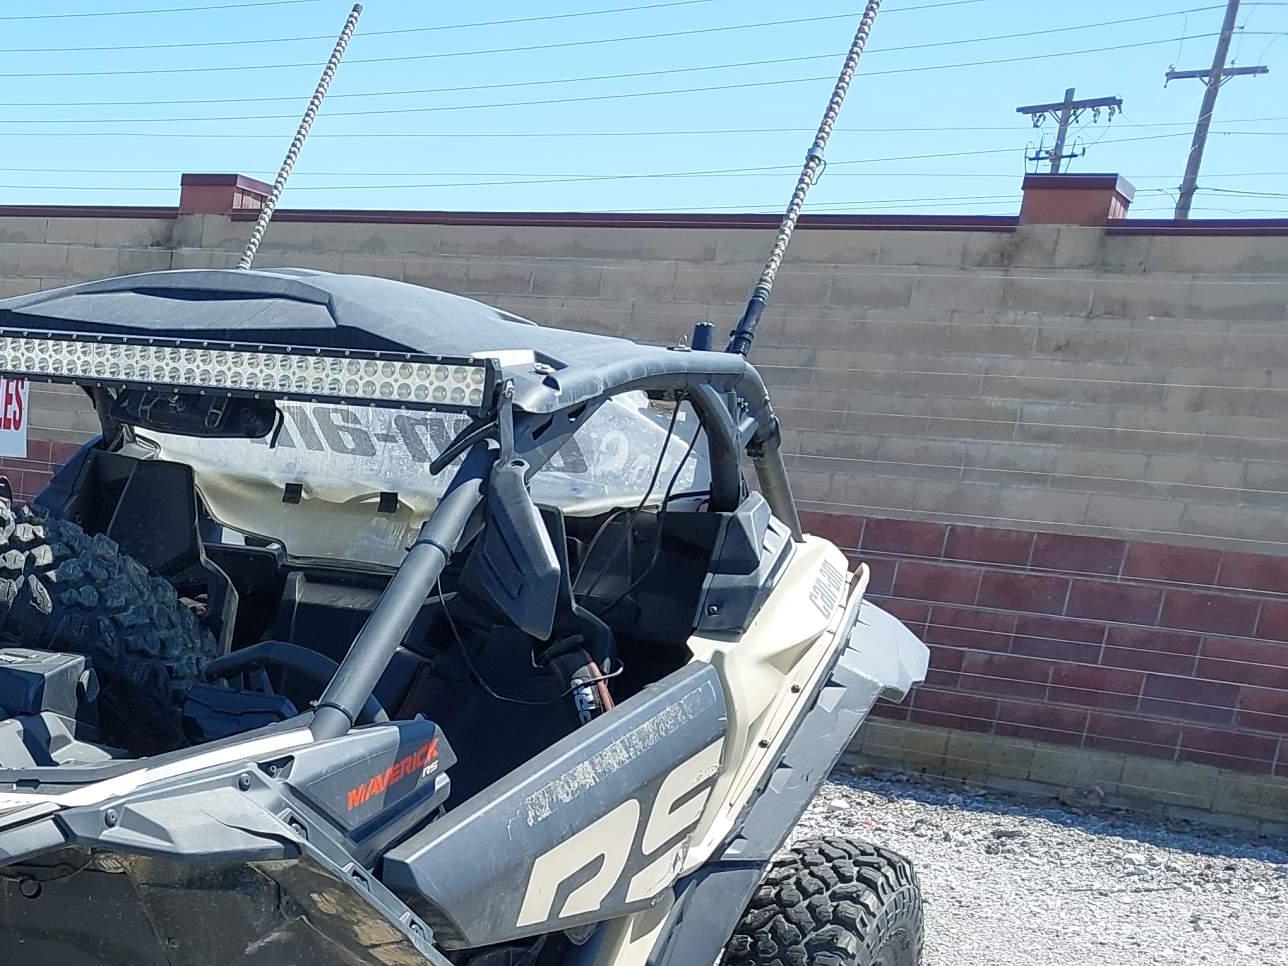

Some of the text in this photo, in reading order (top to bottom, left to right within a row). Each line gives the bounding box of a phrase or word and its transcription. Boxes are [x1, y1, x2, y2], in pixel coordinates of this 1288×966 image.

[346, 738, 440, 812] MAVERICK
[422, 759, 439, 778] RS
[515, 731, 725, 927] RS
